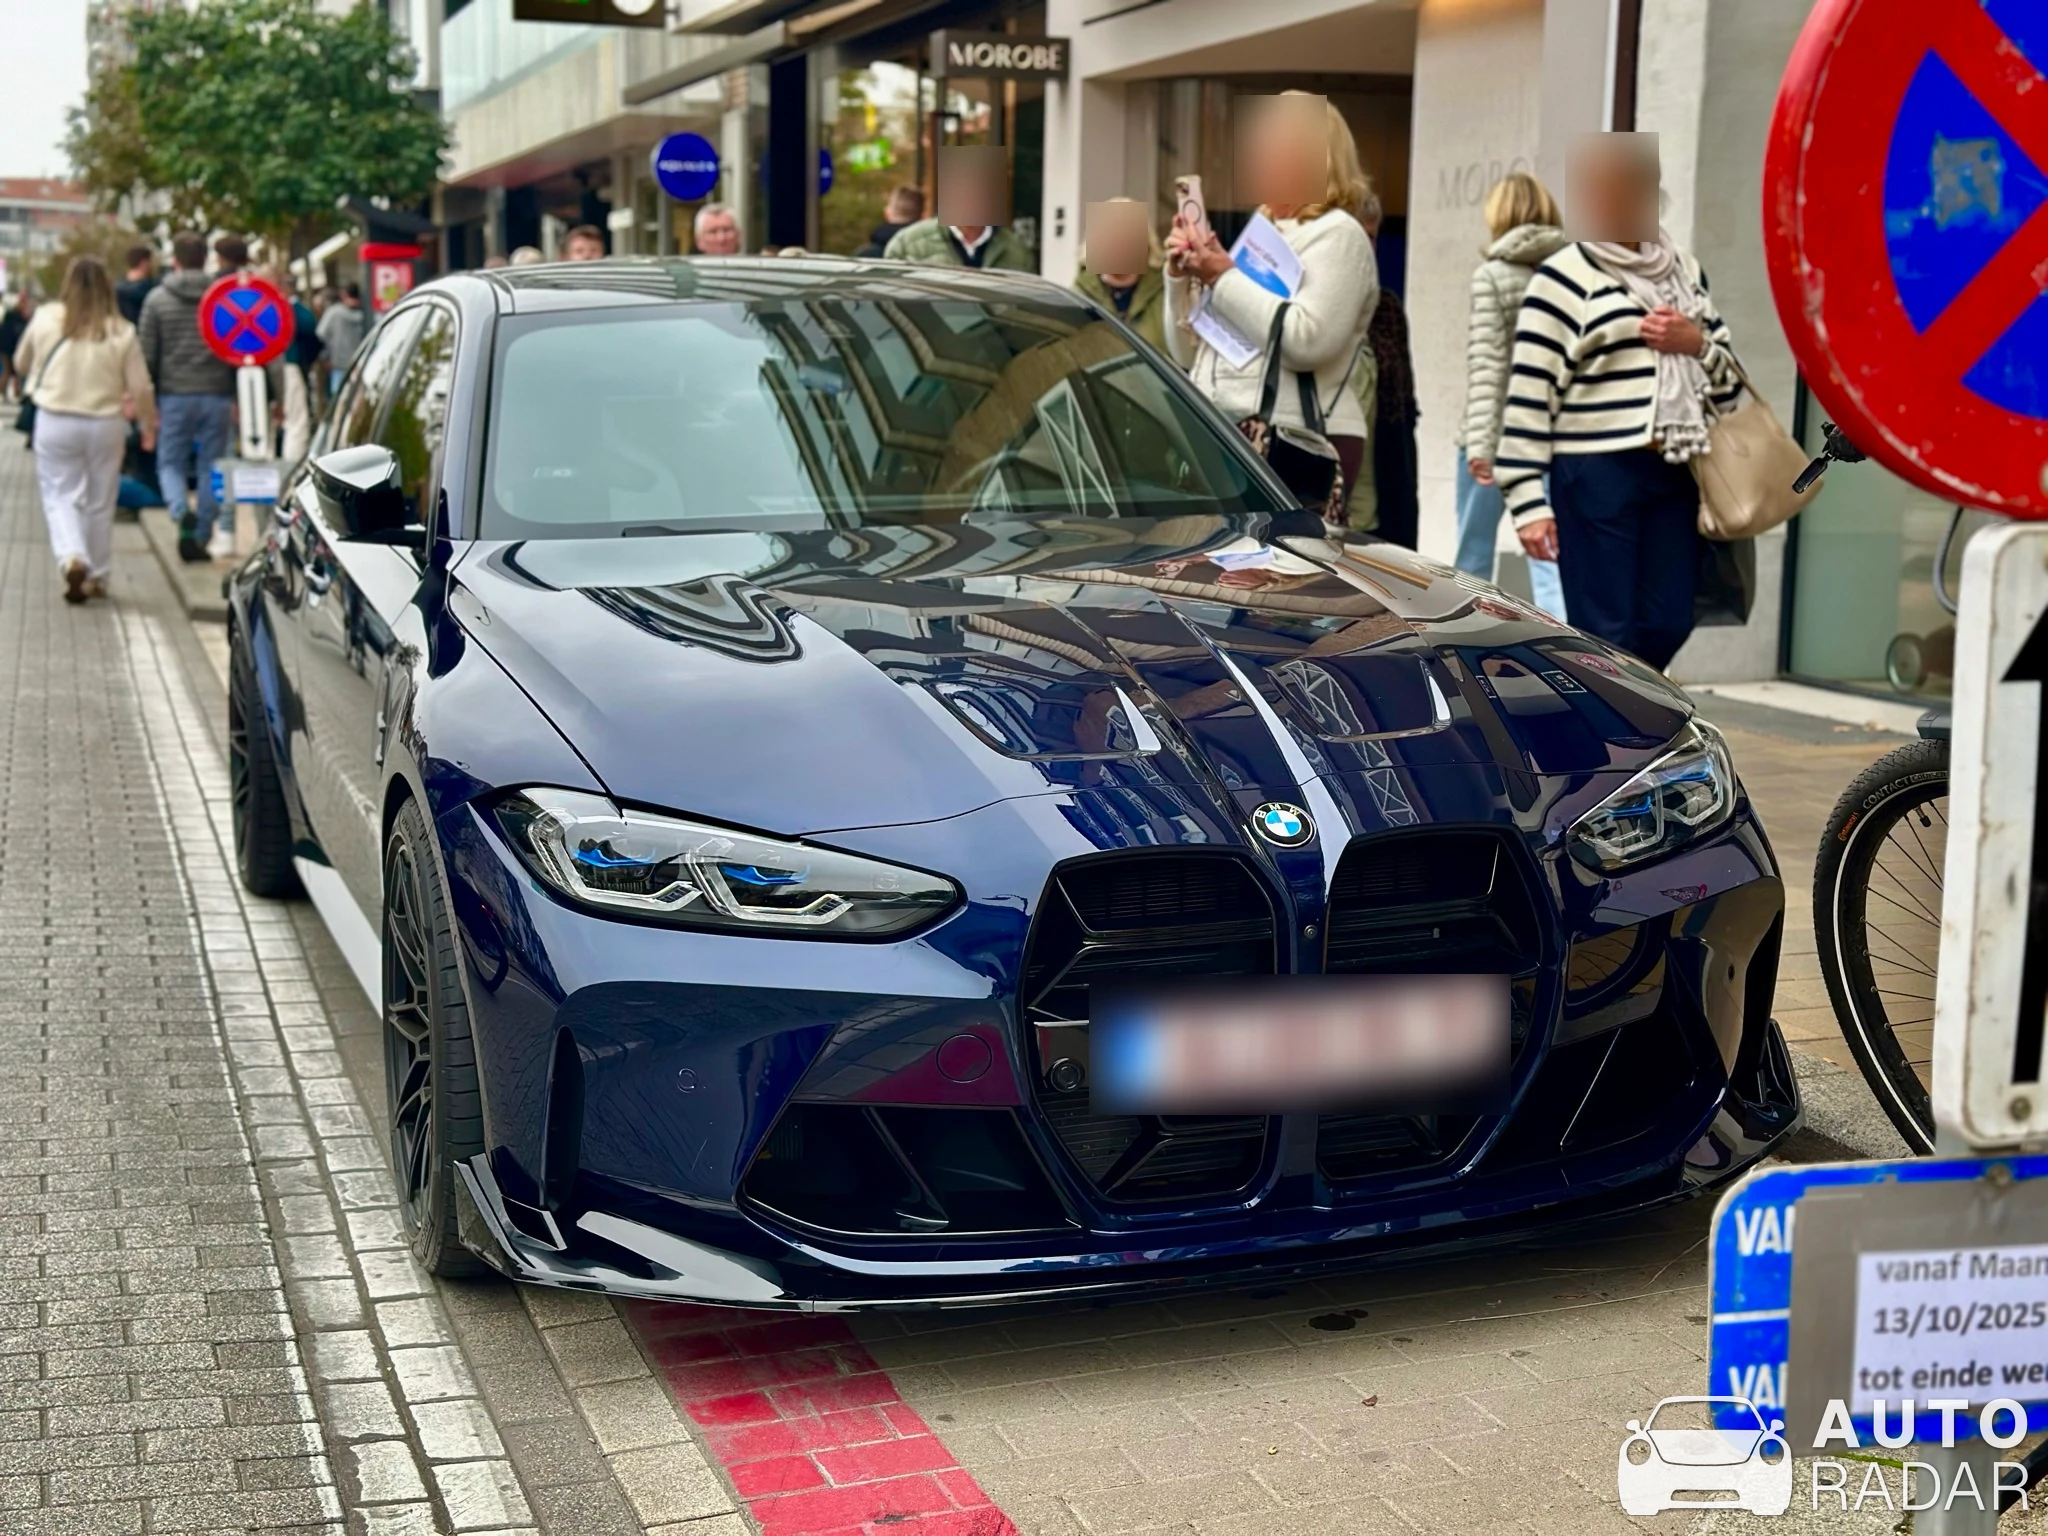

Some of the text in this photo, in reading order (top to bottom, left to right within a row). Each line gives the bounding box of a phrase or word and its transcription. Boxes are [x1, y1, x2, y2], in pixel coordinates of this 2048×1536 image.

[948, 42, 1063, 71] MOROBE
[1862, 776, 1912, 810] CONTACT
[1255, 803, 1300, 817] BMW
[1876, 1252, 1962, 1283] vanaf
[1874, 1301, 2047, 1339] 13/10/2025
[1859, 1359, 2048, 1392] tot einde we
